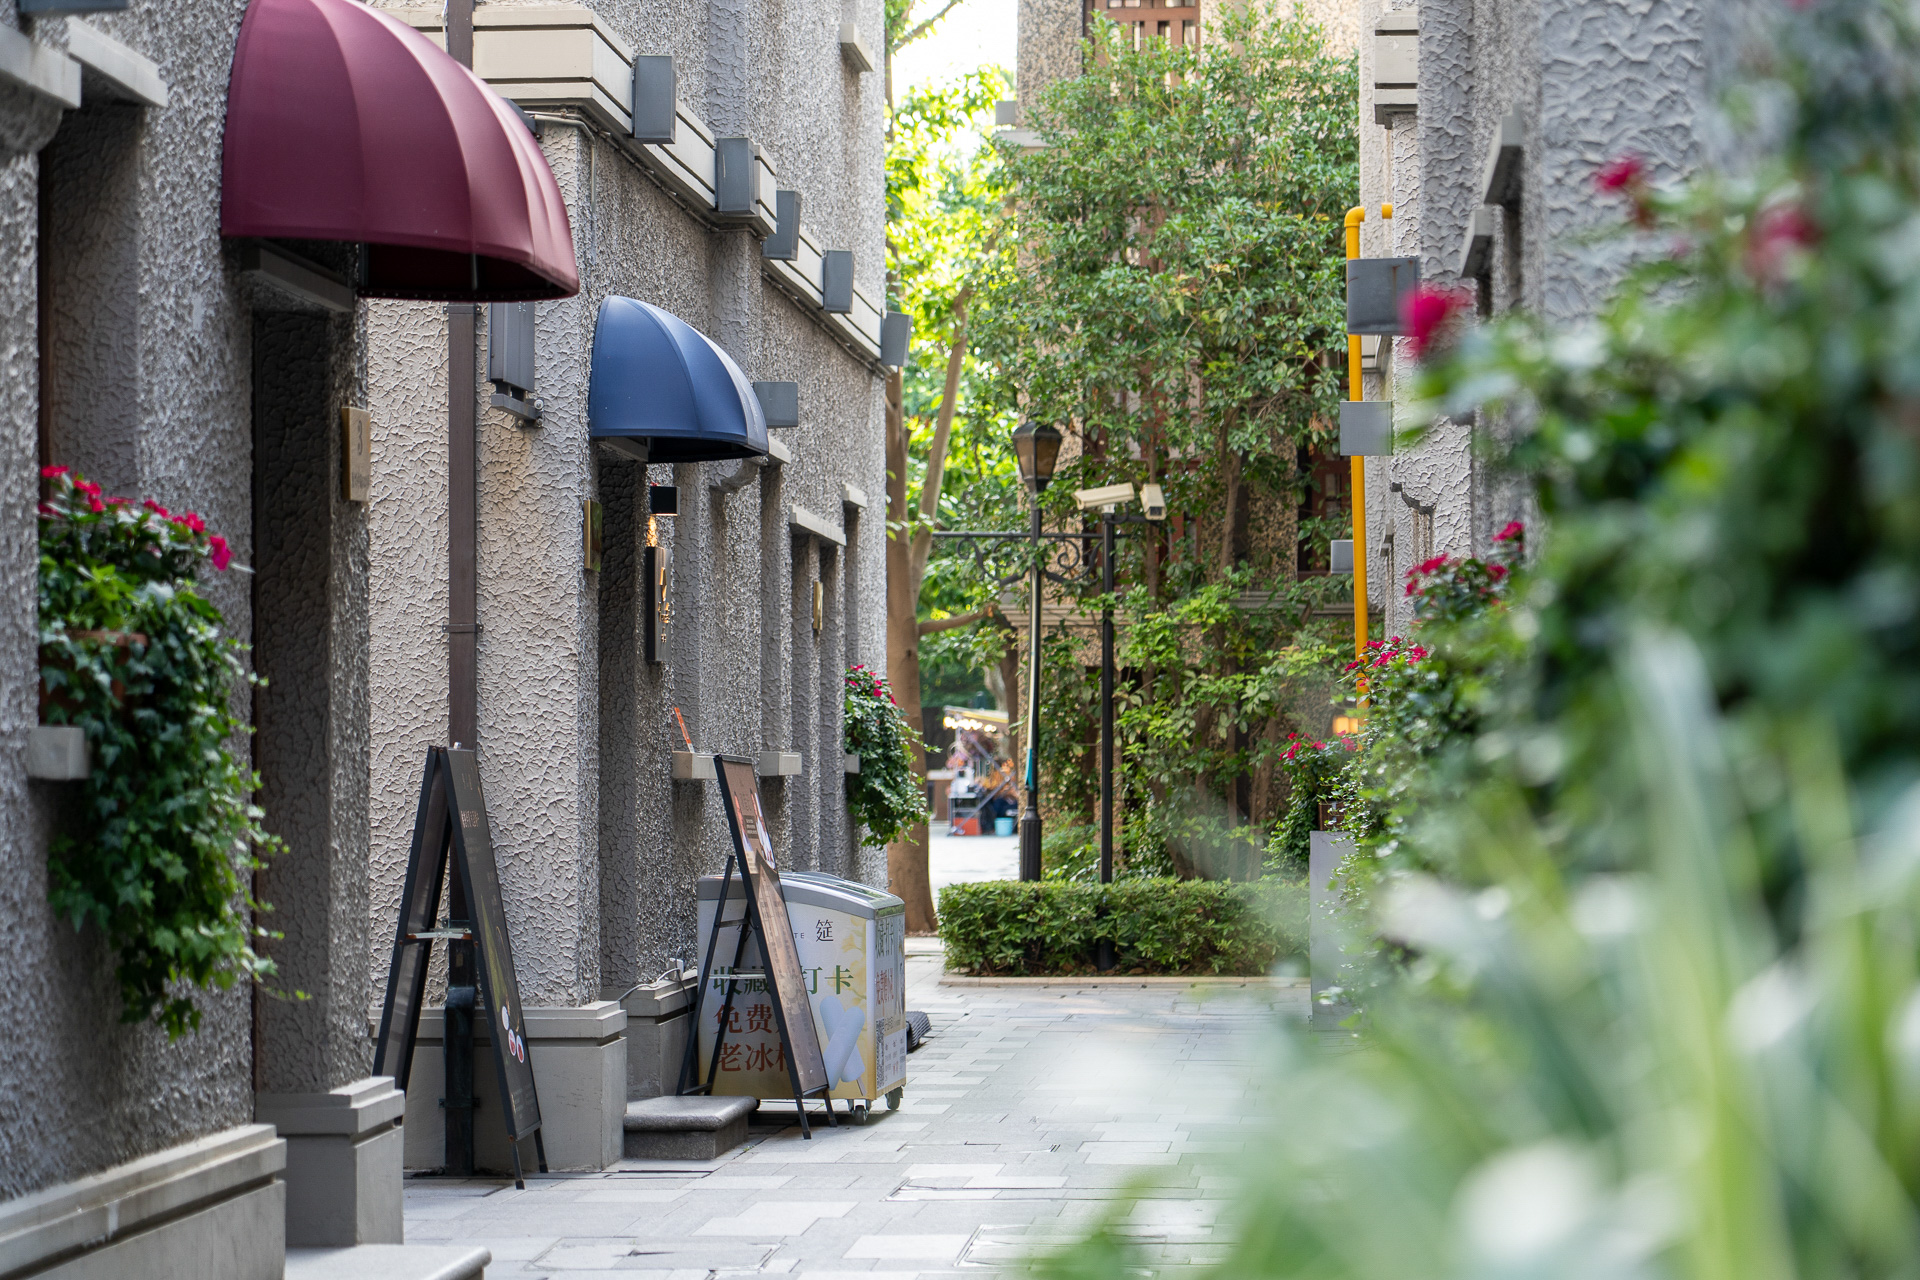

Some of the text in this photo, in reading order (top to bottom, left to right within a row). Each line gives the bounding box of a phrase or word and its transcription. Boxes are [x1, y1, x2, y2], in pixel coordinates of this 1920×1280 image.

[357, 420, 363, 456] 3
[816, 919, 834, 942] 筵
[713, 1004, 779, 1034] 免费
